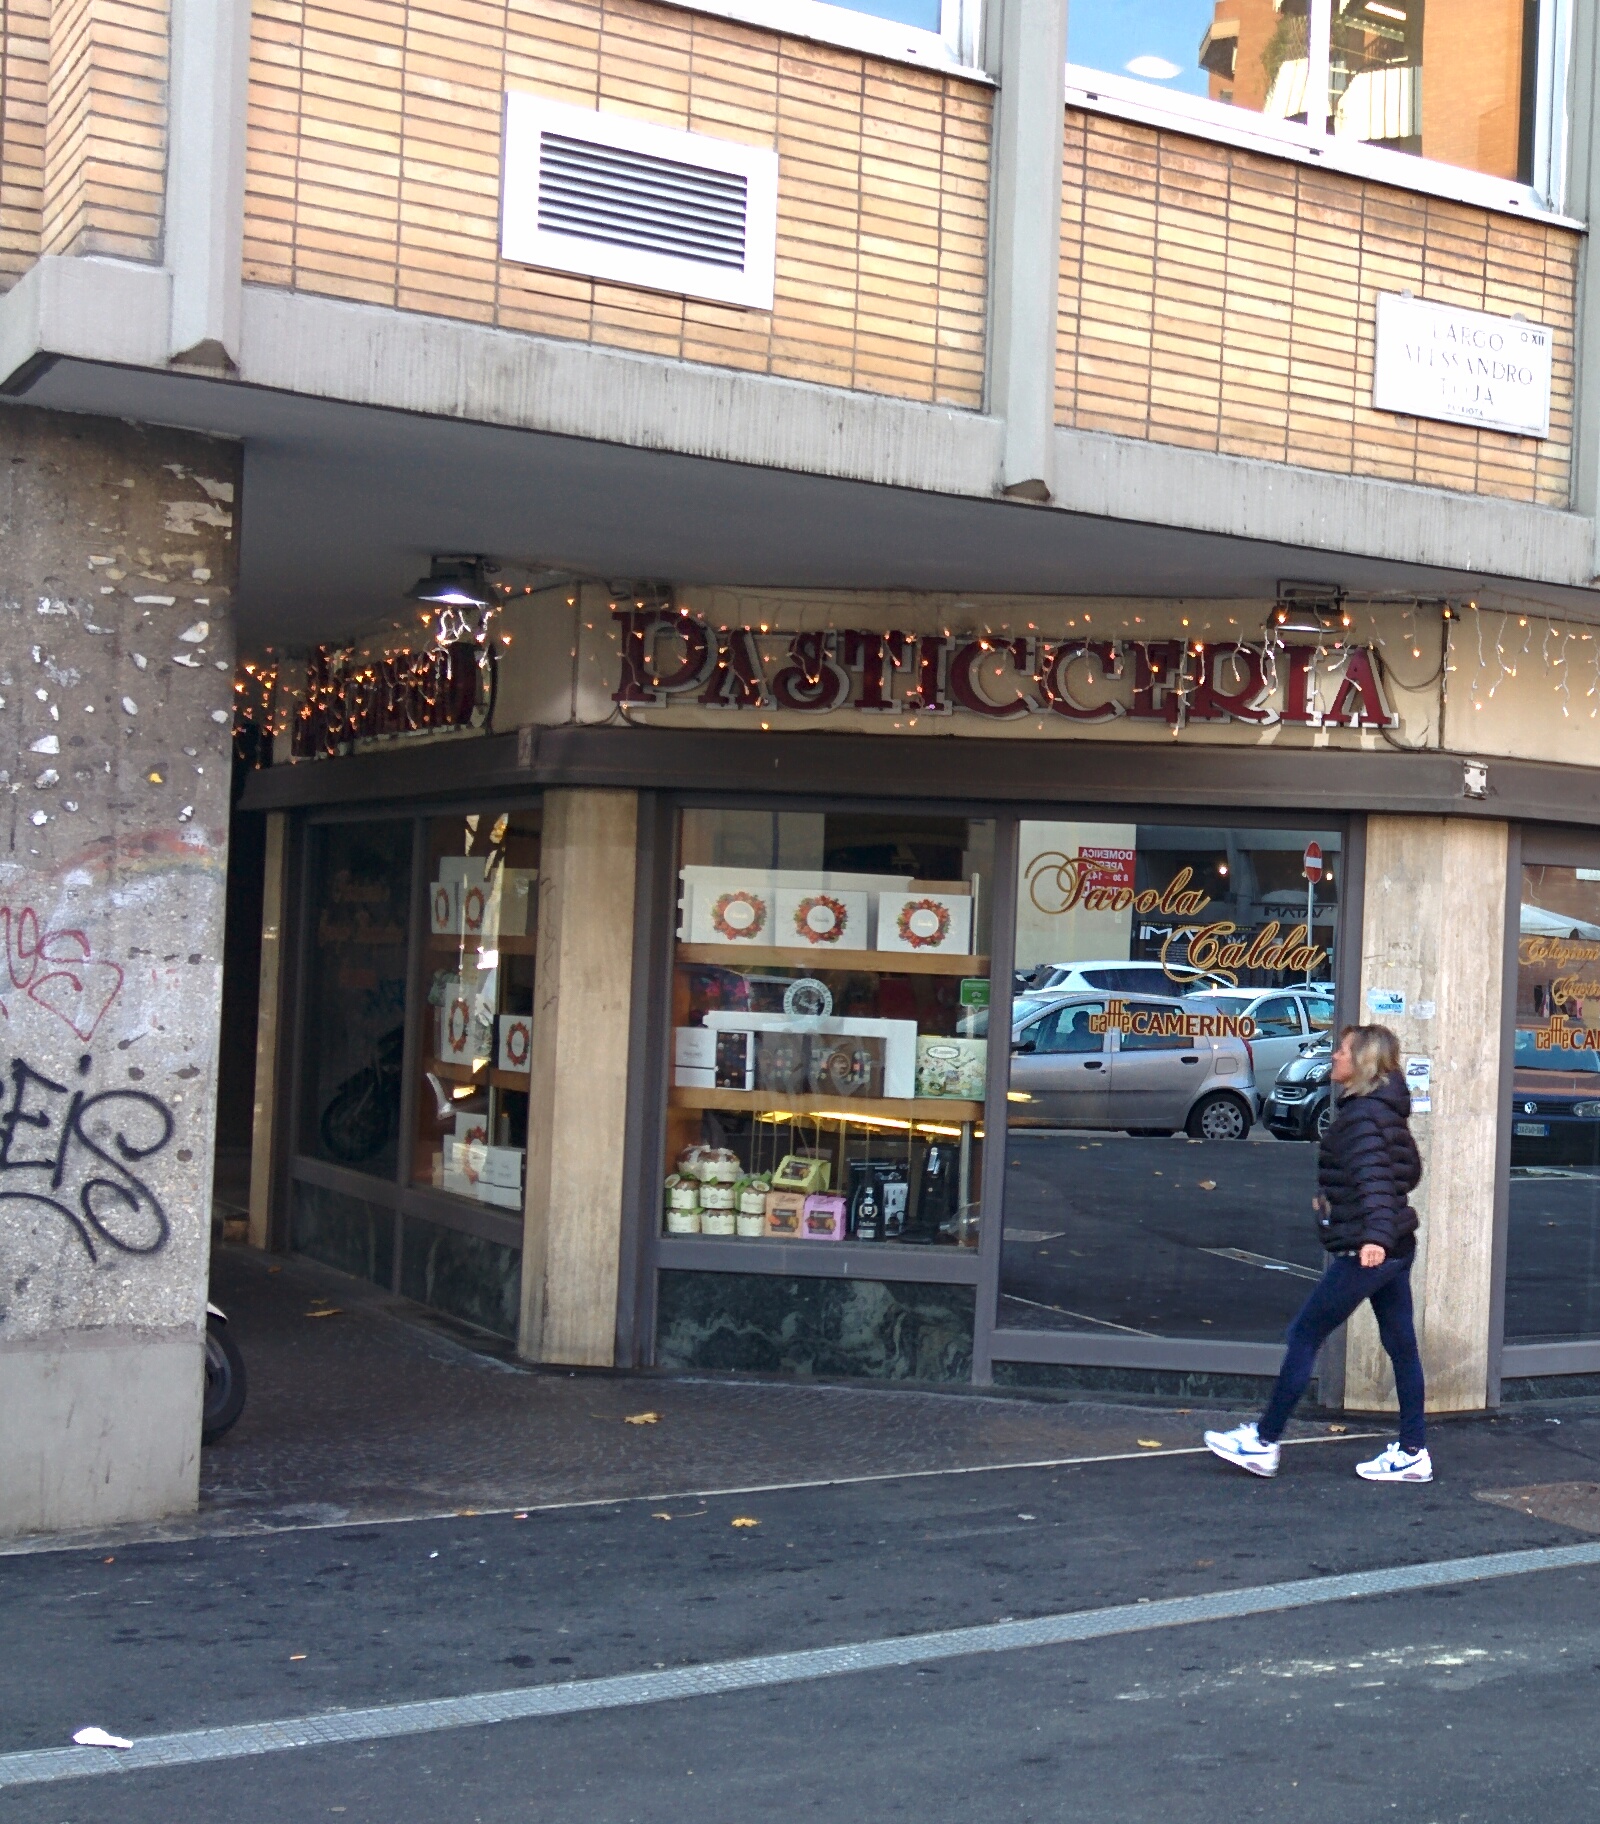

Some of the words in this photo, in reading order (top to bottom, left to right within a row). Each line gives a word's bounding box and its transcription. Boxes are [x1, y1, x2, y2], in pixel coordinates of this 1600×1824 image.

[1432, 319, 1504, 352] LARGO
[1531, 333, 1545, 347] XII
[611, 610, 1398, 730] PASTICCERIA
[1024, 850, 1212, 916] Tavola
[1160, 920, 1328, 987] Calda
[1131, 1010, 1257, 1039] CAMERINO
